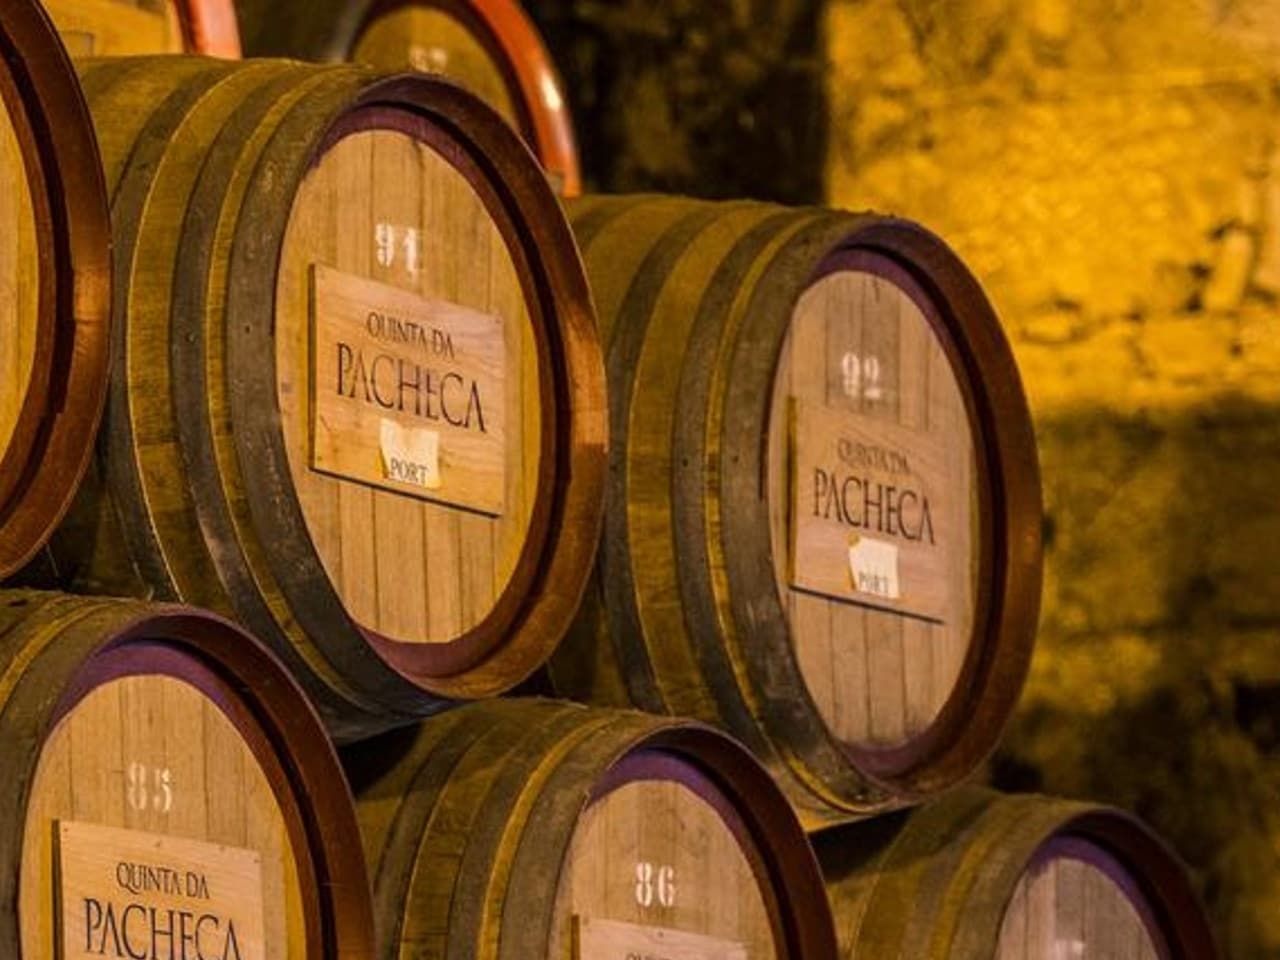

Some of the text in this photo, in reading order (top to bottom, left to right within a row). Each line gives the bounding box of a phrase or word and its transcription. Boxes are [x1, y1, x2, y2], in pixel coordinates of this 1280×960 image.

[375, 223, 418, 274] 91
[366, 311, 456, 362] QUINTA DA
[335, 341, 487, 433] PACHECA
[389, 457, 428, 487] PORT
[812, 466, 937, 547] PACHECA
[115, 861, 210, 900] QUINTA DA
[635, 861, 675, 908] 86
